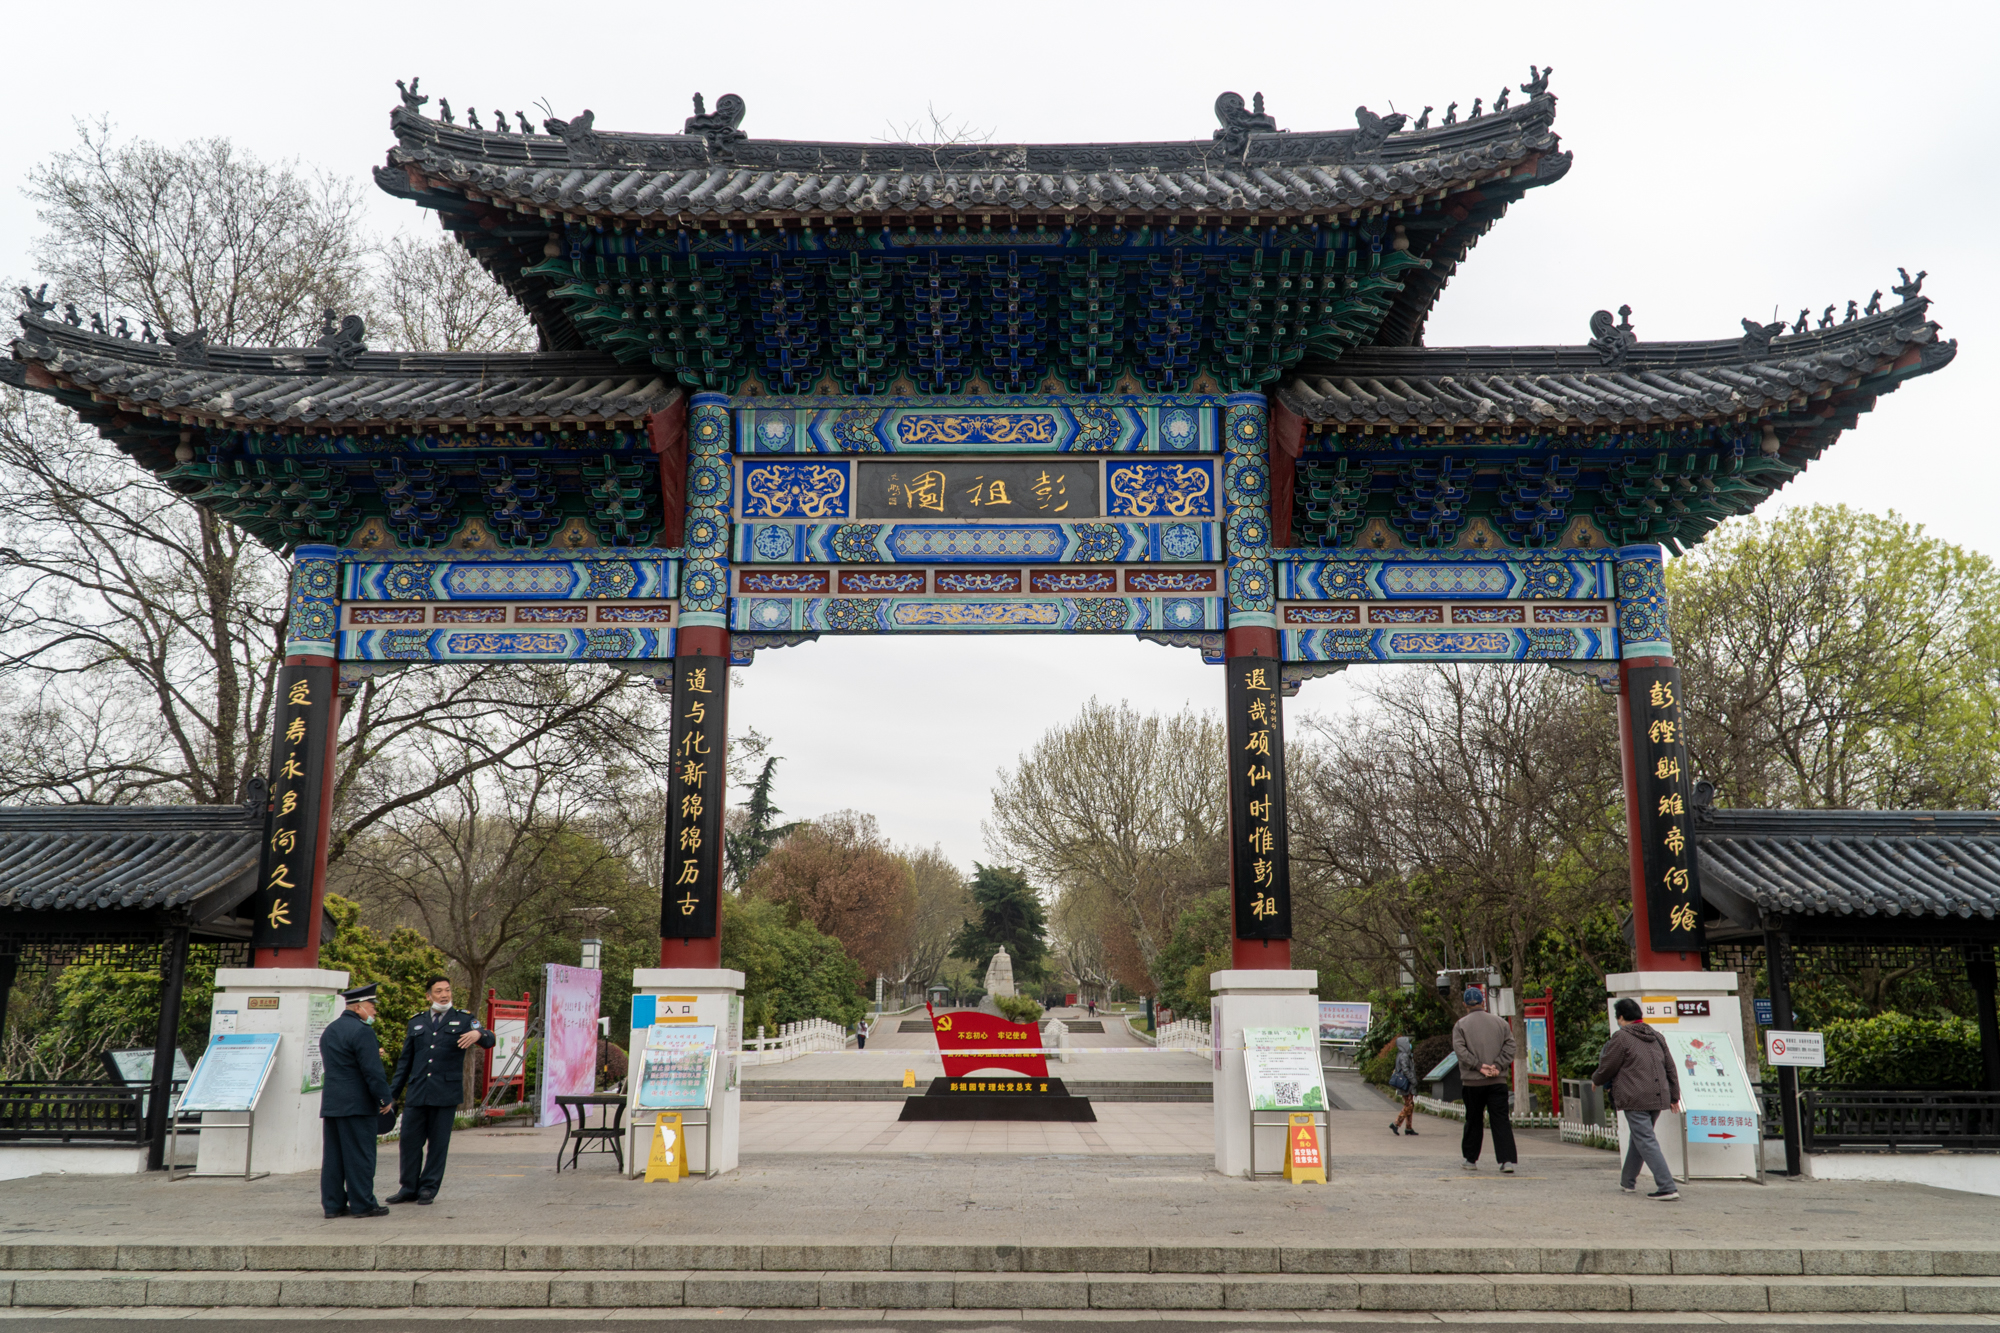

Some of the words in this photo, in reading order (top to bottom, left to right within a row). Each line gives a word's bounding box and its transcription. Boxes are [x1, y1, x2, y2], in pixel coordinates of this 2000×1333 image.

[675, 667, 712, 916] 道与化新绵绵历古
[1244, 667, 1278, 922] 遐哉硕仙时惟彭祖
[266, 679, 312, 929] 受寿永多何久长
[665, 1005, 690, 1014] 入口
[1646, 1006, 1672, 1015] 出口
[1678, 1003, 1696, 1011] 母婴室
[957, 1031, 988, 1040] 不忘初心
[997, 1031, 1028, 1040] 牢记使命
[950, 1082, 1033, 1092] 彭祖园管理处党总支
[1040, 1083, 1048, 1092] 宣
[1691, 1115, 1753, 1127] 志愿者服务驿站
[1294, 1148, 1318, 1156] 高空坠物
[1295, 1156, 1319, 1164] 注意安全
